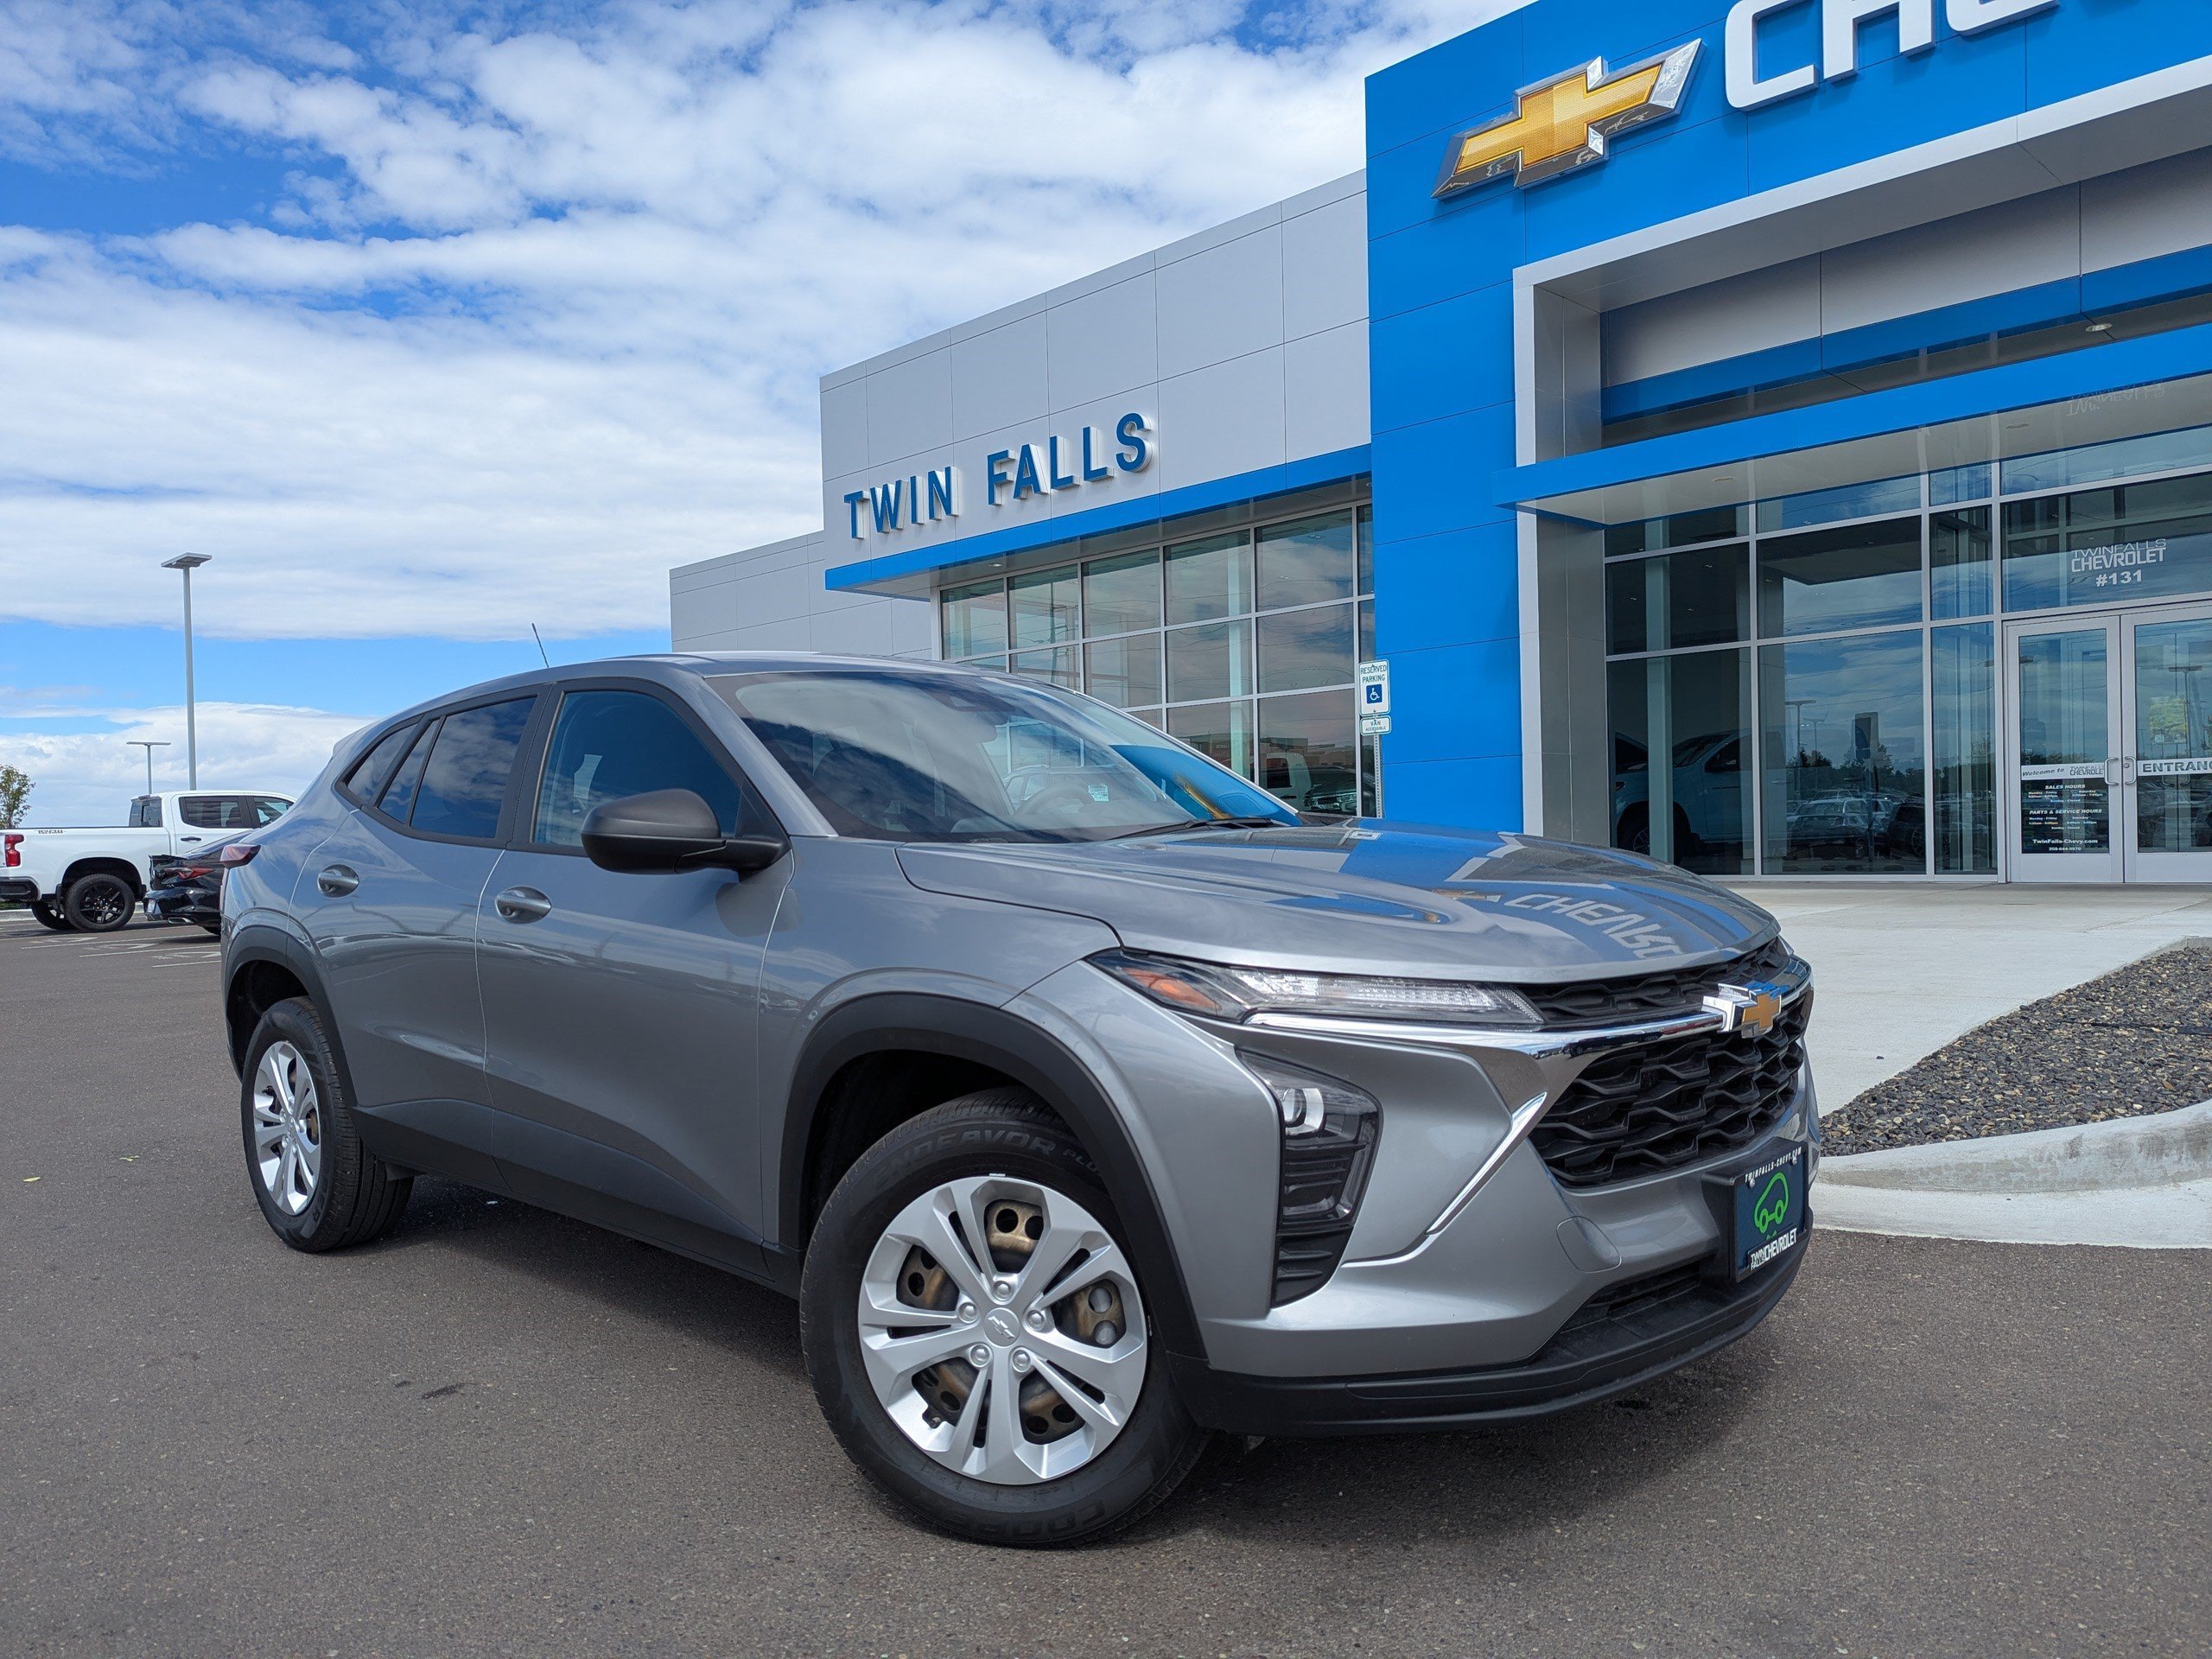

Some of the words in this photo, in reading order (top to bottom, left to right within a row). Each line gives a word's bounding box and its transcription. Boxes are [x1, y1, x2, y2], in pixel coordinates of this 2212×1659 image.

[843, 466, 960, 540] TWIN
[987, 412, 1153, 506] FALLS
[2073, 538, 2166, 558] TWINFALLS
[2071, 547, 2166, 572] CHEVROLET
[2095, 569, 2142, 587] #131
[1360, 664, 1387, 675] RESERVED
[1362, 674, 1385, 683] PARKING
[1764, 1227, 1796, 1262] CHEVROLET
